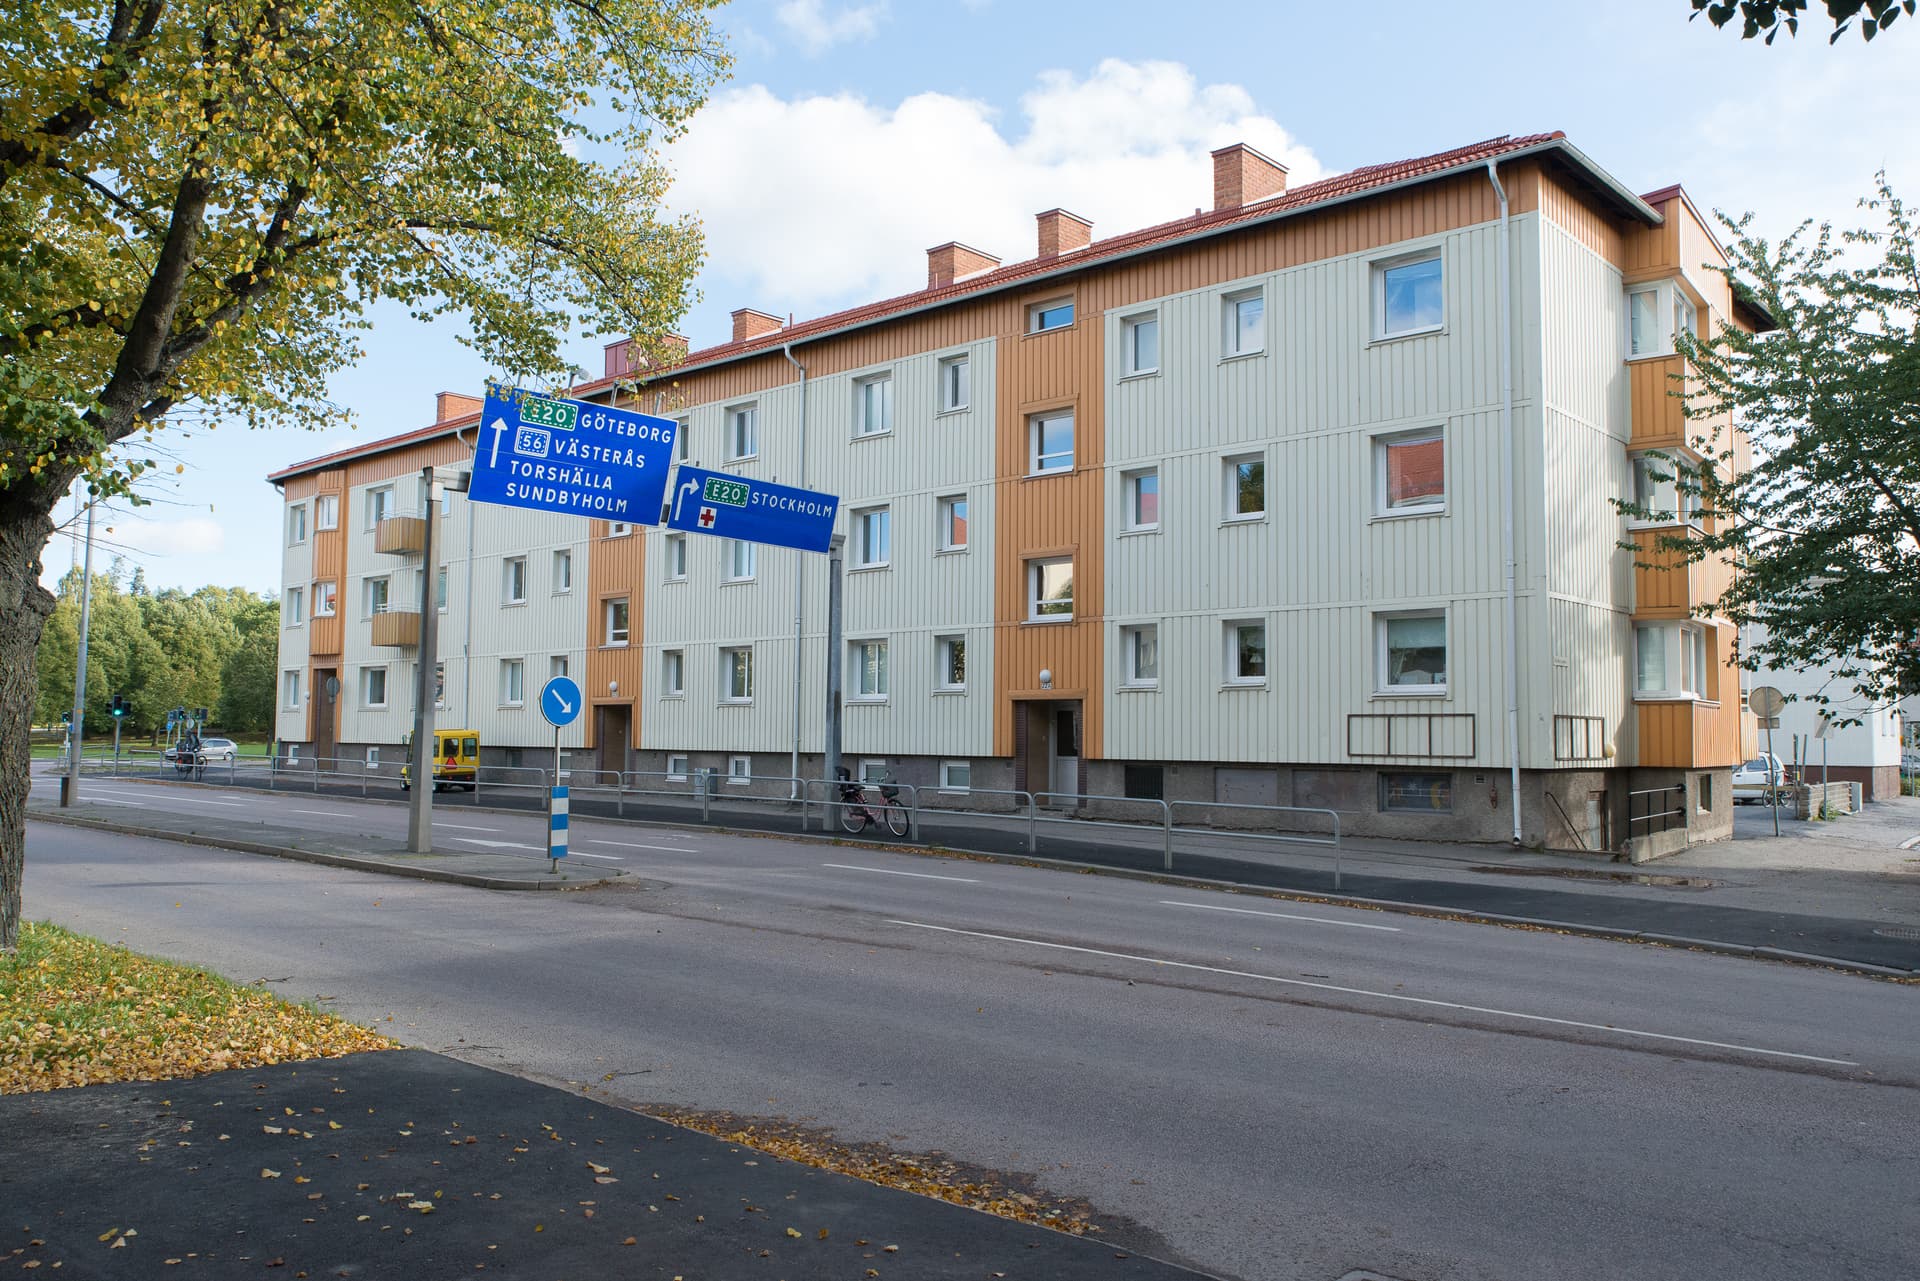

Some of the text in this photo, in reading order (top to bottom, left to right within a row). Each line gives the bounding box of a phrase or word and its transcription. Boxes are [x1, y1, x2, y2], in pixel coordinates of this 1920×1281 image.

[531, 404, 671, 443] E20 GÖTEBORG
[522, 435, 645, 468] 56 VÄSTERÅS
[511, 460, 612, 490] TORSHÄLLA
[506, 482, 627, 513] SUNDBYHOLM
[712, 484, 832, 517] E20 STOCKHOLM
